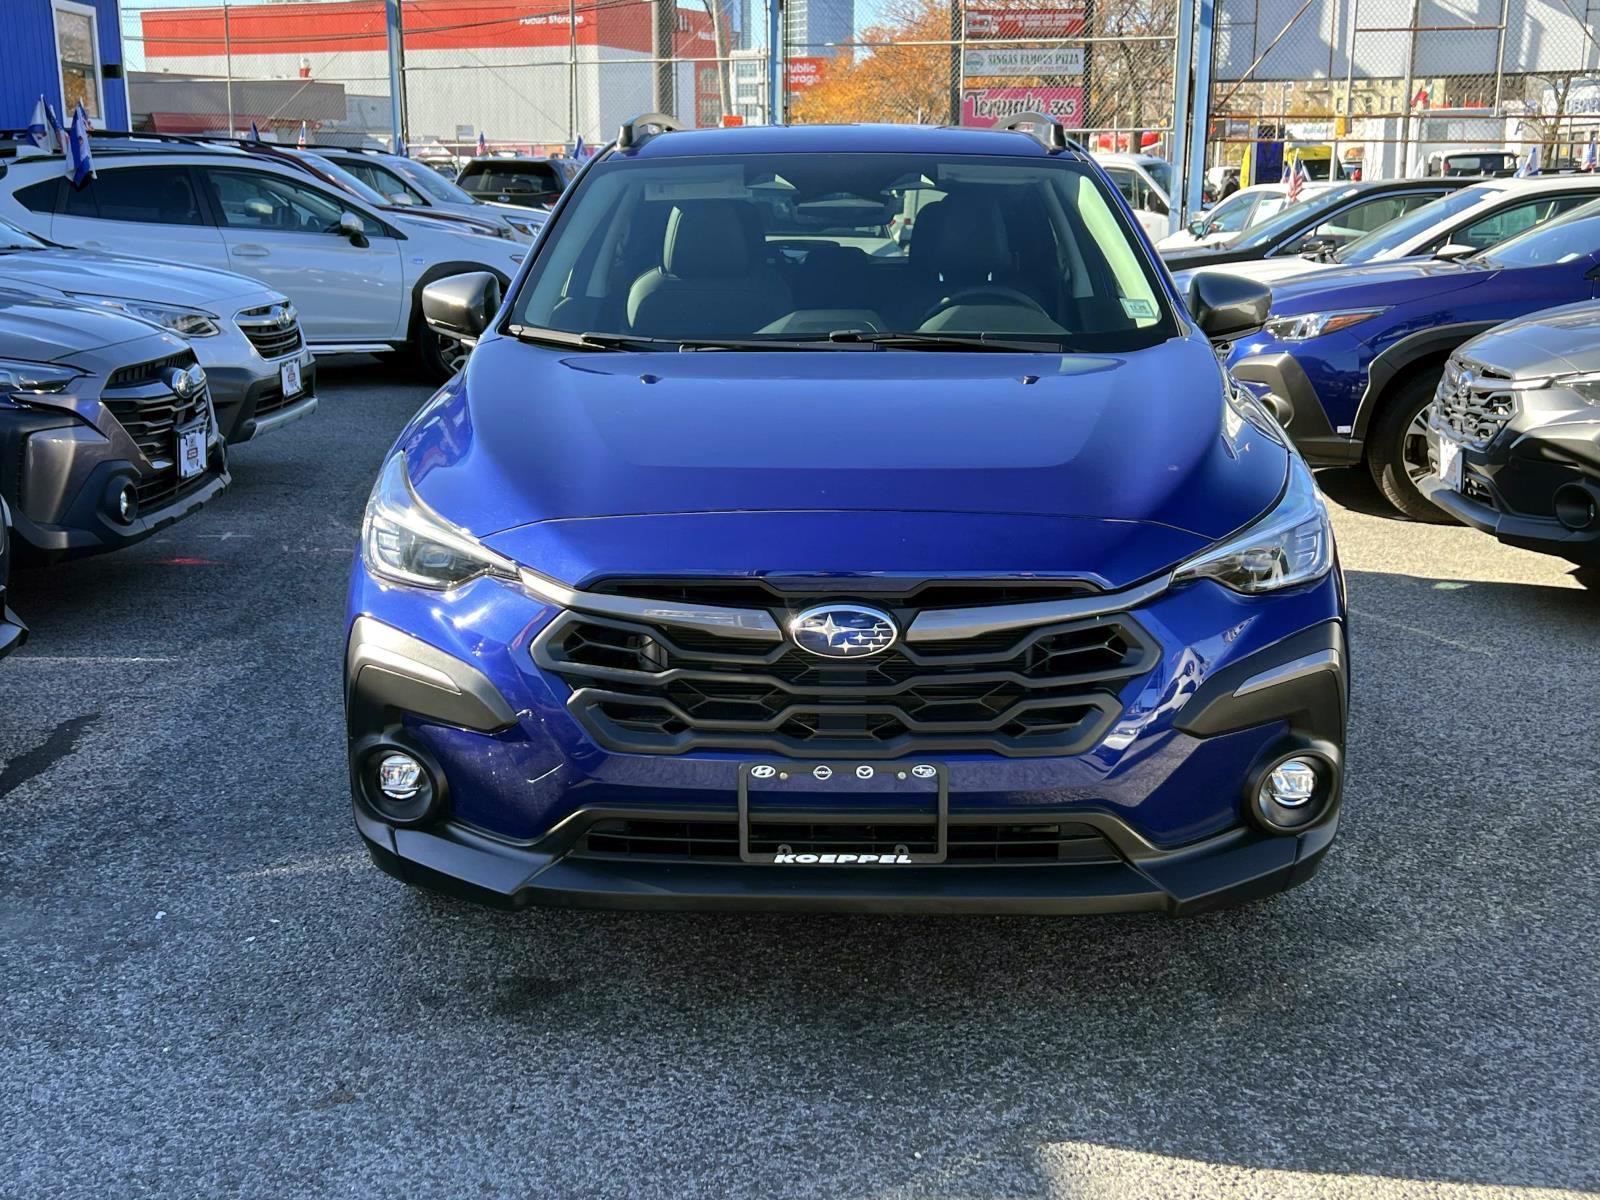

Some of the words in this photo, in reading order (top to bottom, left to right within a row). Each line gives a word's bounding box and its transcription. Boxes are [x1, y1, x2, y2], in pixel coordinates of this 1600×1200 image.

[548, 15, 584, 25] Storae
[1055, 53, 1079, 65] PIZZA
[1050, 100, 1075, 116] 365
[773, 854, 912, 864] KOEPPEL
